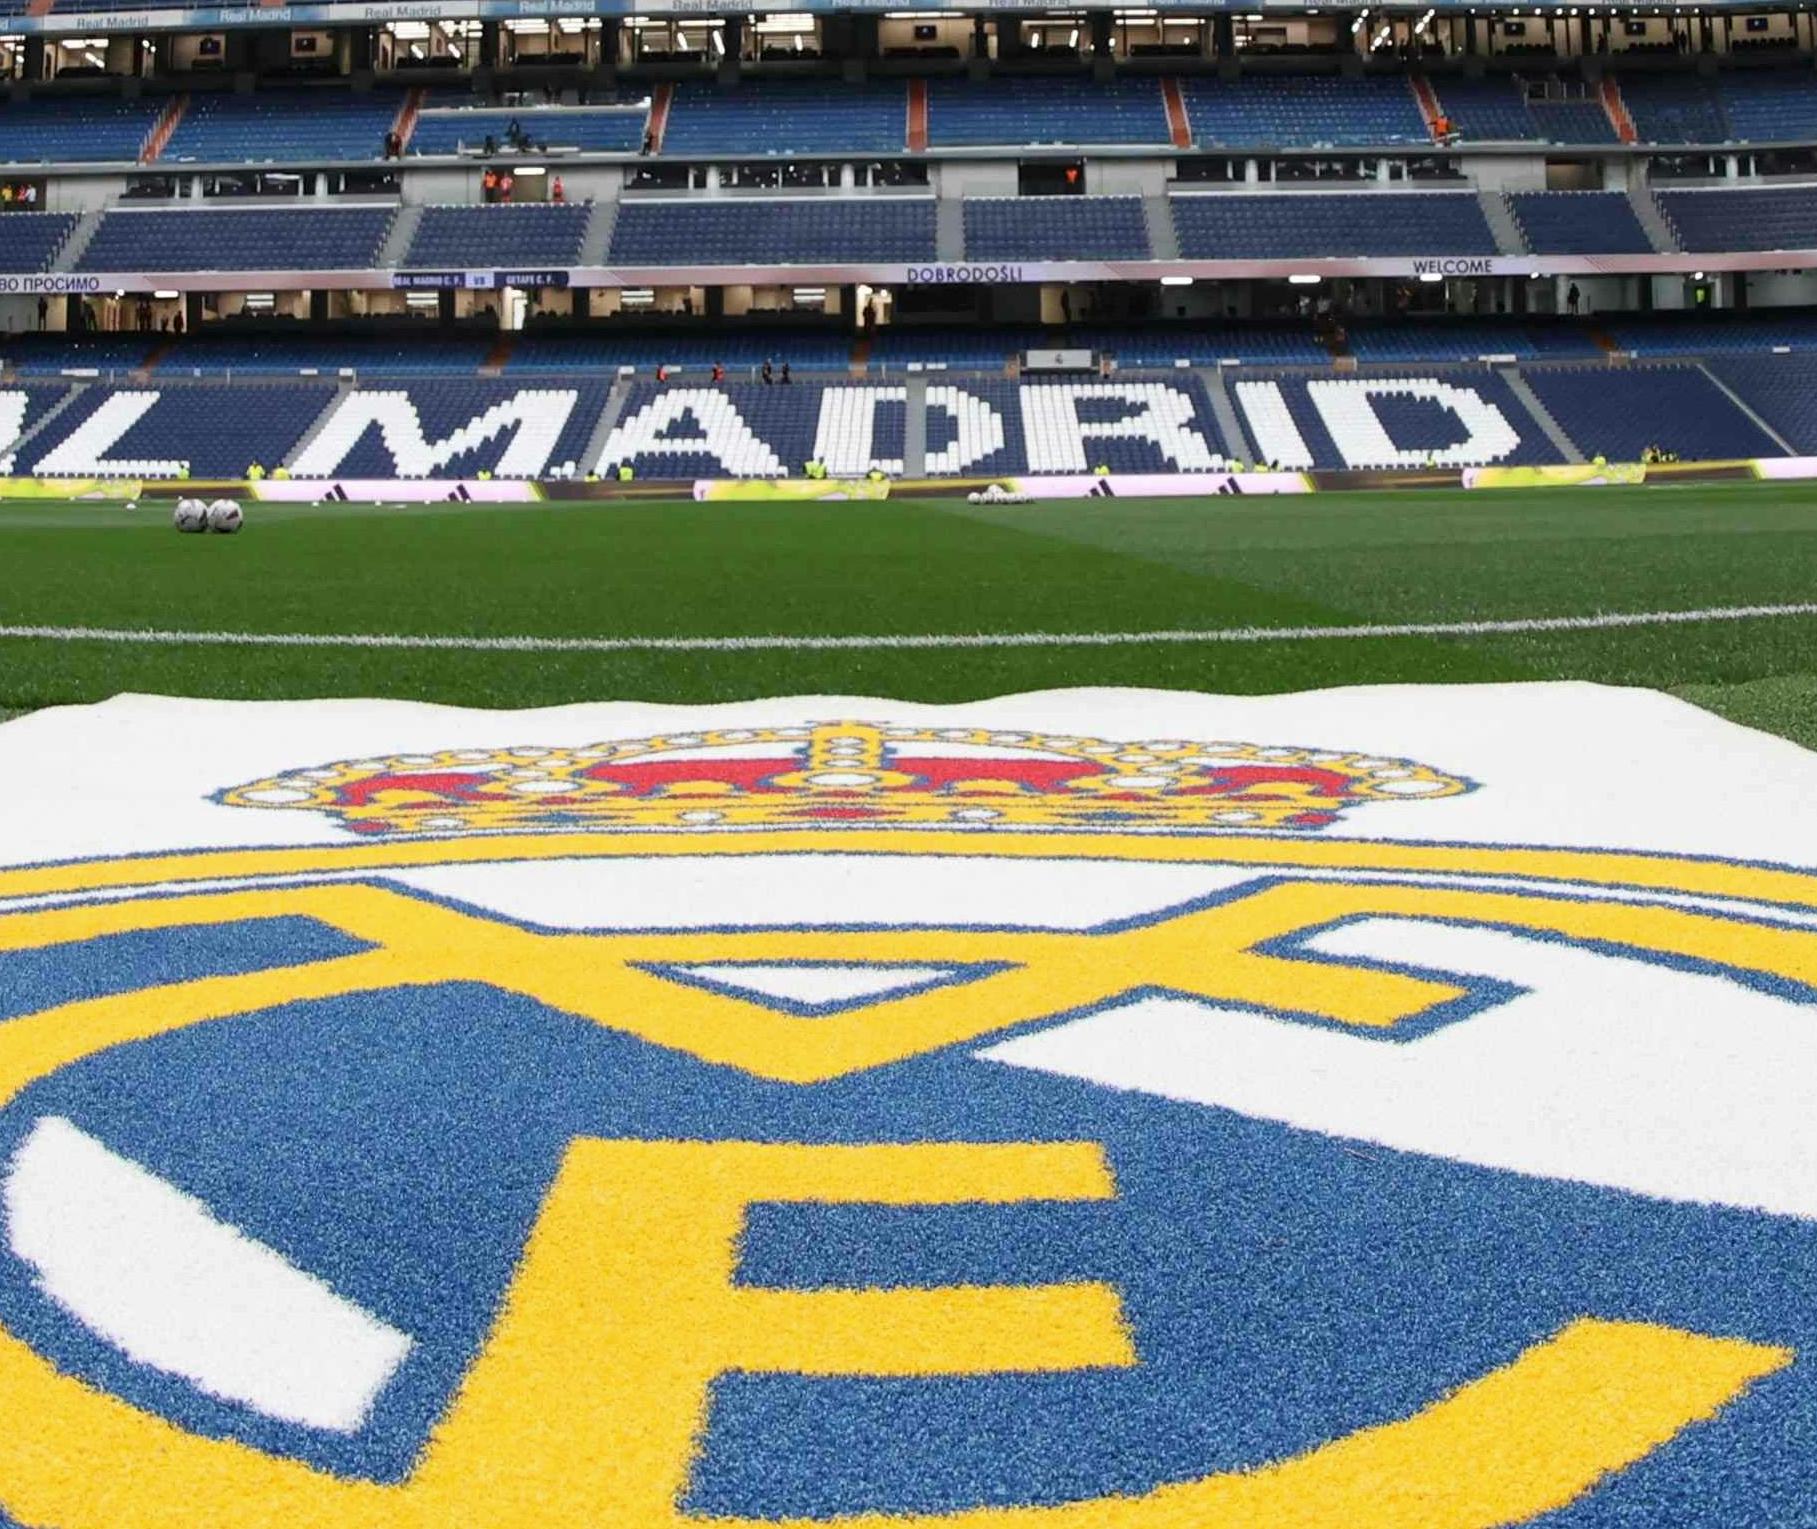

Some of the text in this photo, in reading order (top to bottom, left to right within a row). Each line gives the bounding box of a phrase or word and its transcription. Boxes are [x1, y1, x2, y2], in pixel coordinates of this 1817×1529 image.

[365, 5, 442, 18] Real Madrid
[519, 0, 596, 11] Real Madrid
[672, 0, 699, 11] Real
[219, 7, 292, 22] Real Madrid
[77, 16, 149, 29] Real Madrid
[1413, 259, 1492, 273] WELCOME
[23, 277, 100, 291] ПРОСИМО
[288, 377, 1521, 479] MADRID
